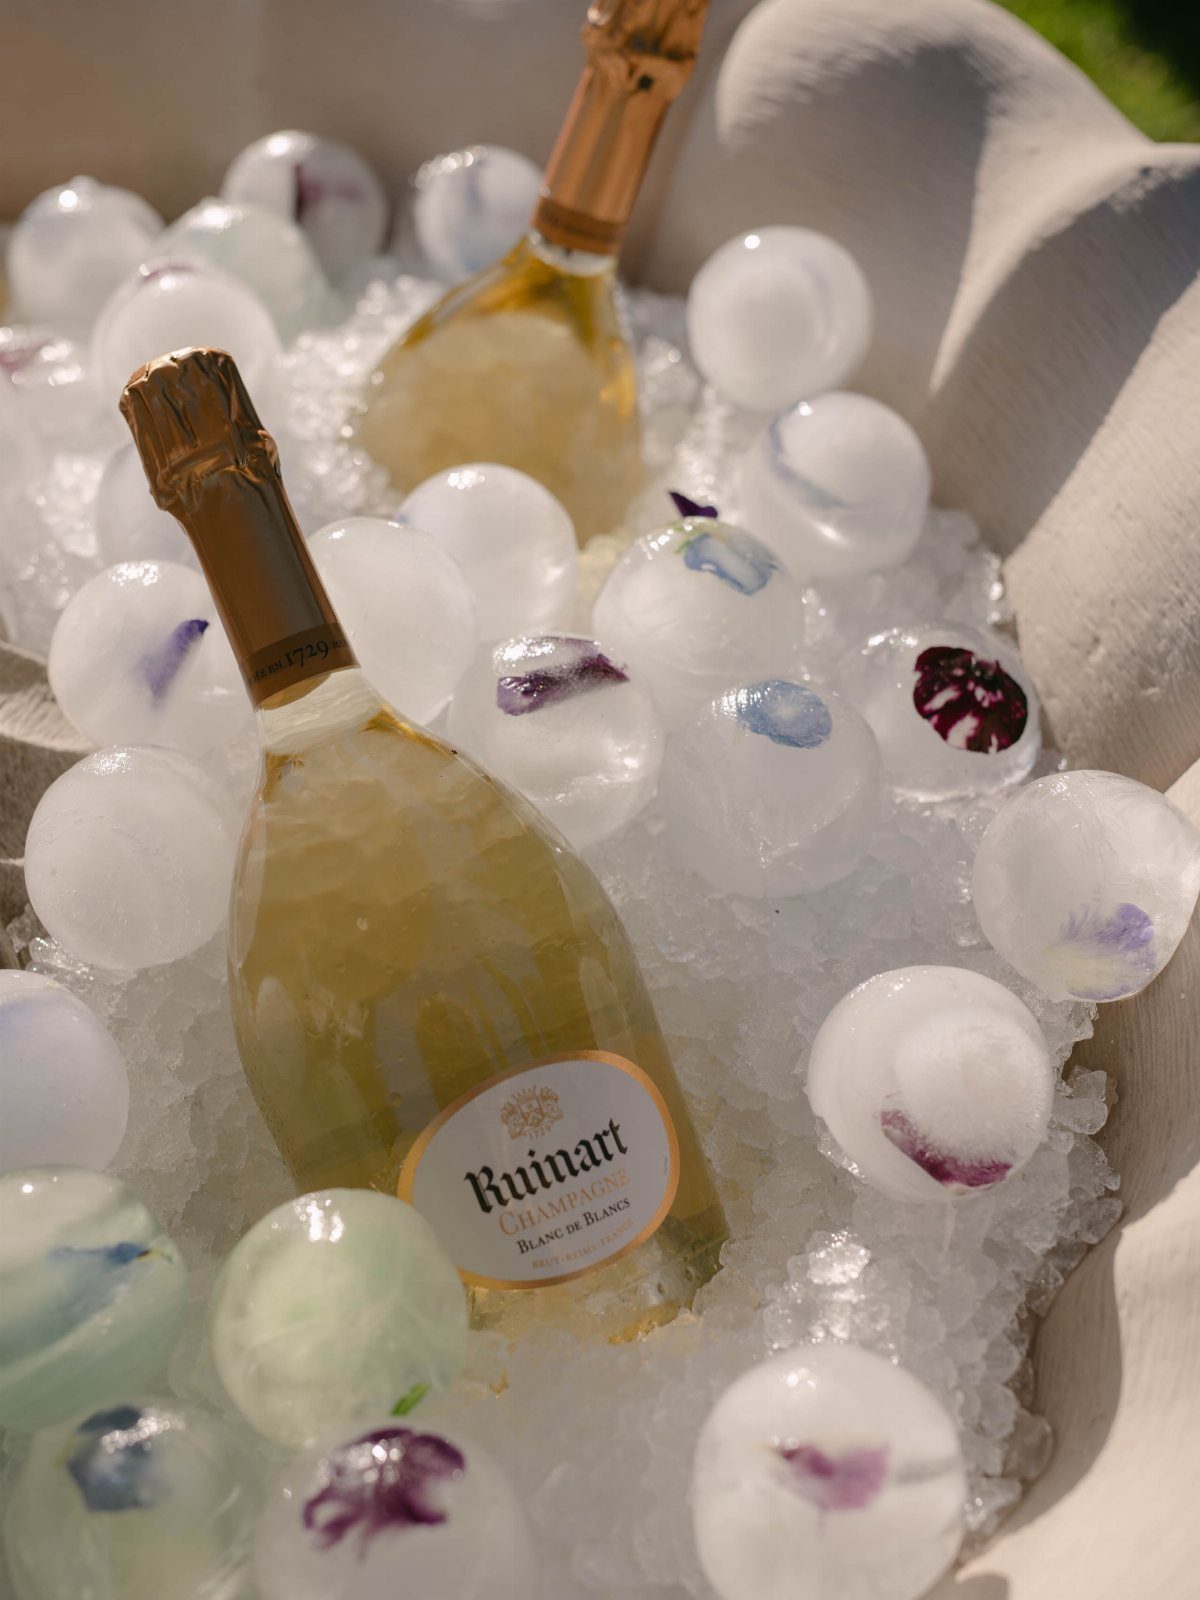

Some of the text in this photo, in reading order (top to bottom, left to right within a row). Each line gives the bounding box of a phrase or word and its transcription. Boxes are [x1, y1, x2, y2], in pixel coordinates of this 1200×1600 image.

[285, 640, 330, 667] 1729
[464, 1117, 628, 1214] Ruinart
[498, 1168, 631, 1236] CHAMPAGNE
[516, 1198, 631, 1254] BLANC DE BLANCS
